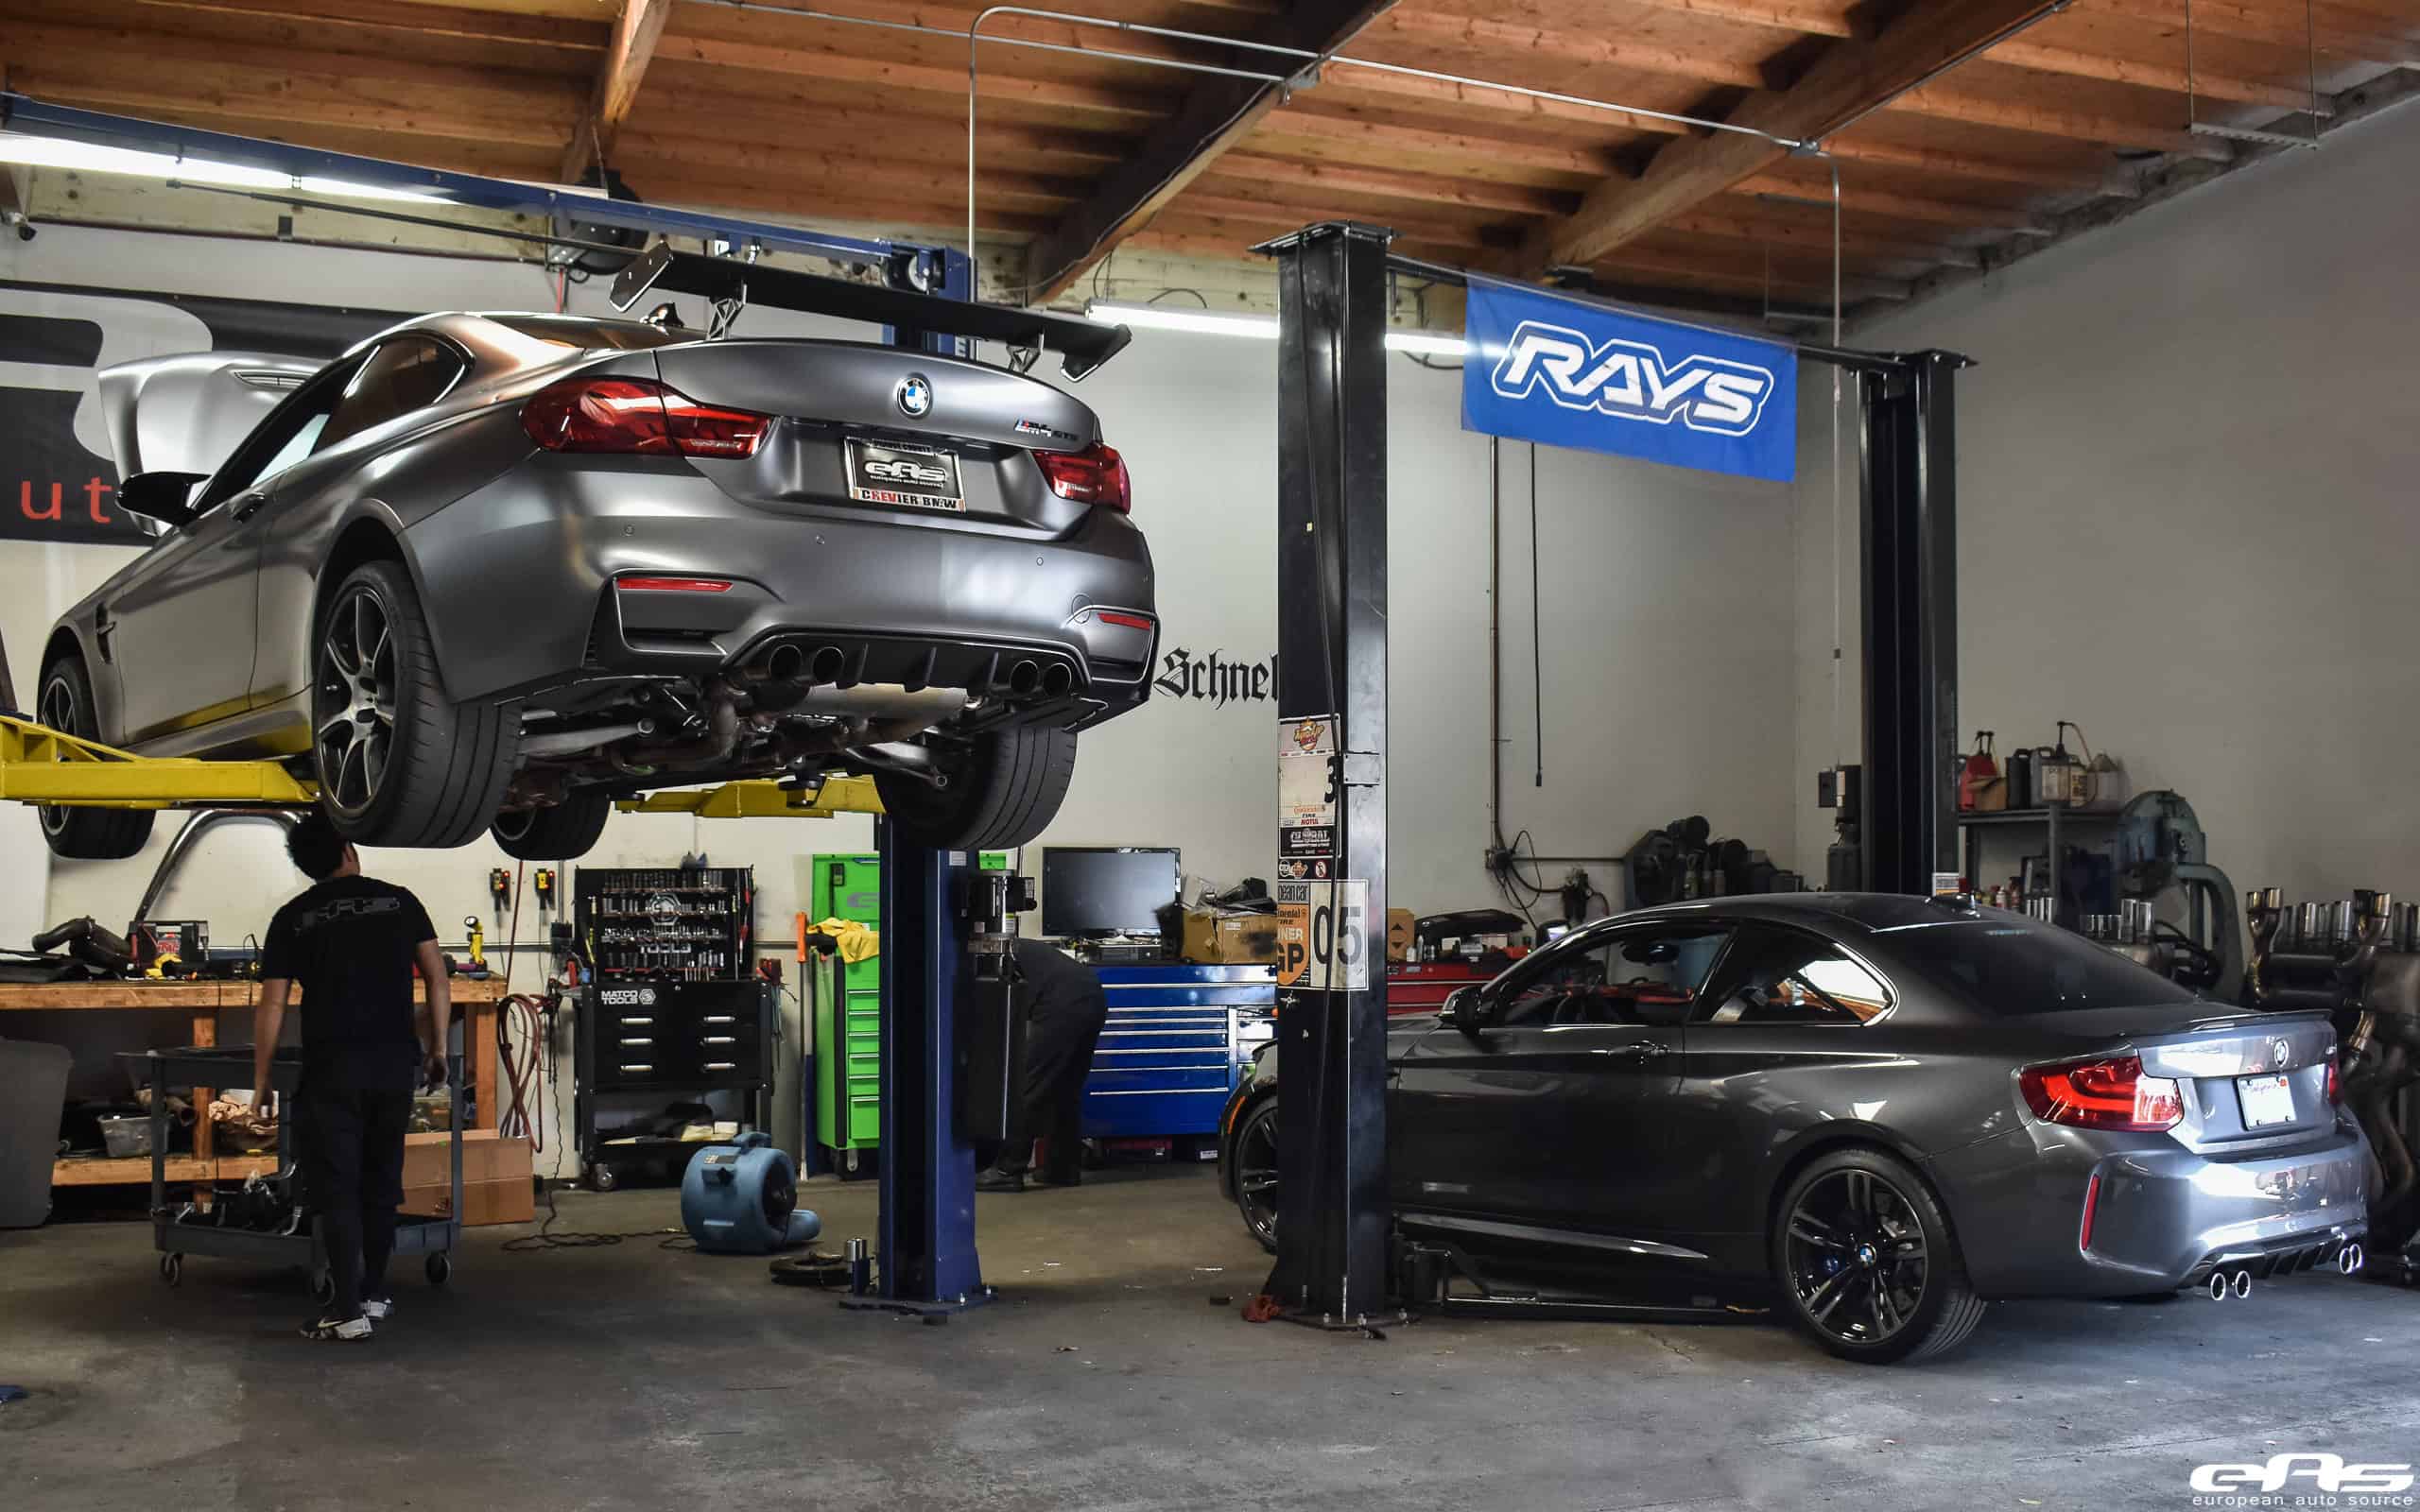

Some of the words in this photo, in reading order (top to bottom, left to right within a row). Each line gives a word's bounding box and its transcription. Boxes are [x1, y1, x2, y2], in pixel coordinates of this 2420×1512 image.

[1500, 332, 1767, 426] RAYS
[923, 498, 957, 508] BMW
[601, 990, 638, 999] MATCO
